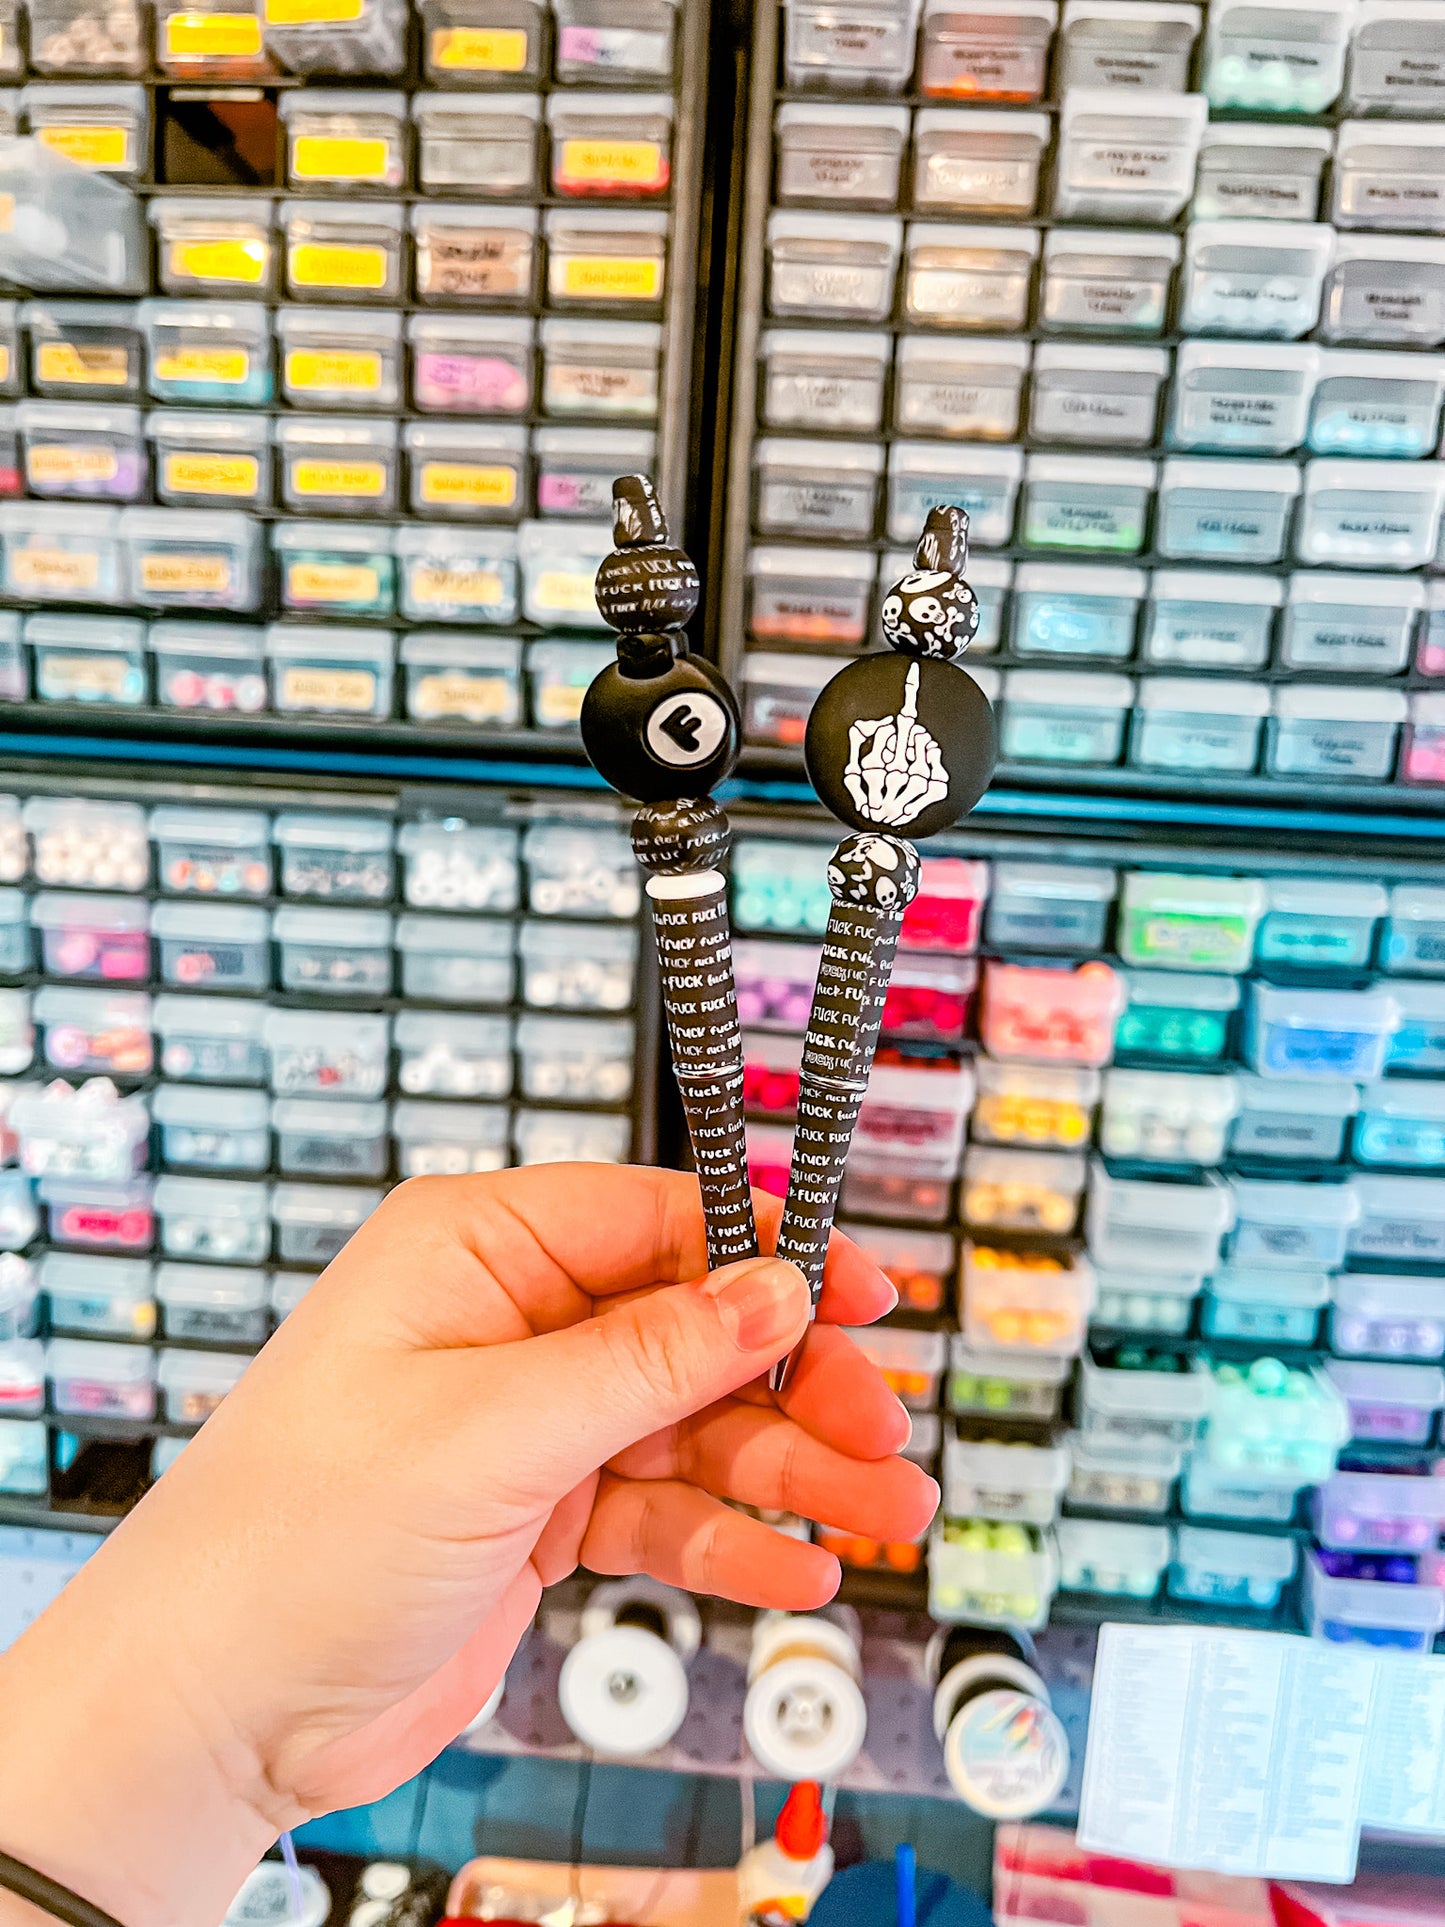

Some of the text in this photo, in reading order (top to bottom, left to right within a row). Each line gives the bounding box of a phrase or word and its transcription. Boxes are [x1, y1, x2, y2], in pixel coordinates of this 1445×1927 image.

[601, 582, 644, 596] FUCK
[659, 705, 702, 752] F
[692, 908, 717, 924] FUCK
[828, 919, 853, 935] FUCK
[701, 997, 726, 1013] FUCK
[813, 1006, 840, 1024] FUCK
[806, 1031, 836, 1048] FUCK
[688, 1084, 721, 1098] fuck
[705, 1102, 728, 1120] fuck
[801, 1102, 833, 1119] FUCK
[699, 1127, 726, 1138] FUCK
[801, 1128, 825, 1142] FUCK
[701, 1148, 732, 1160] FUCK
[704, 1162, 737, 1175] fuck
[798, 1189, 830, 1204] FUCK
[715, 1203, 741, 1215] FUCK
[794, 1215, 819, 1229] FUCK
[718, 1223, 747, 1237] FUCK
[721, 1239, 753, 1255] fuck
